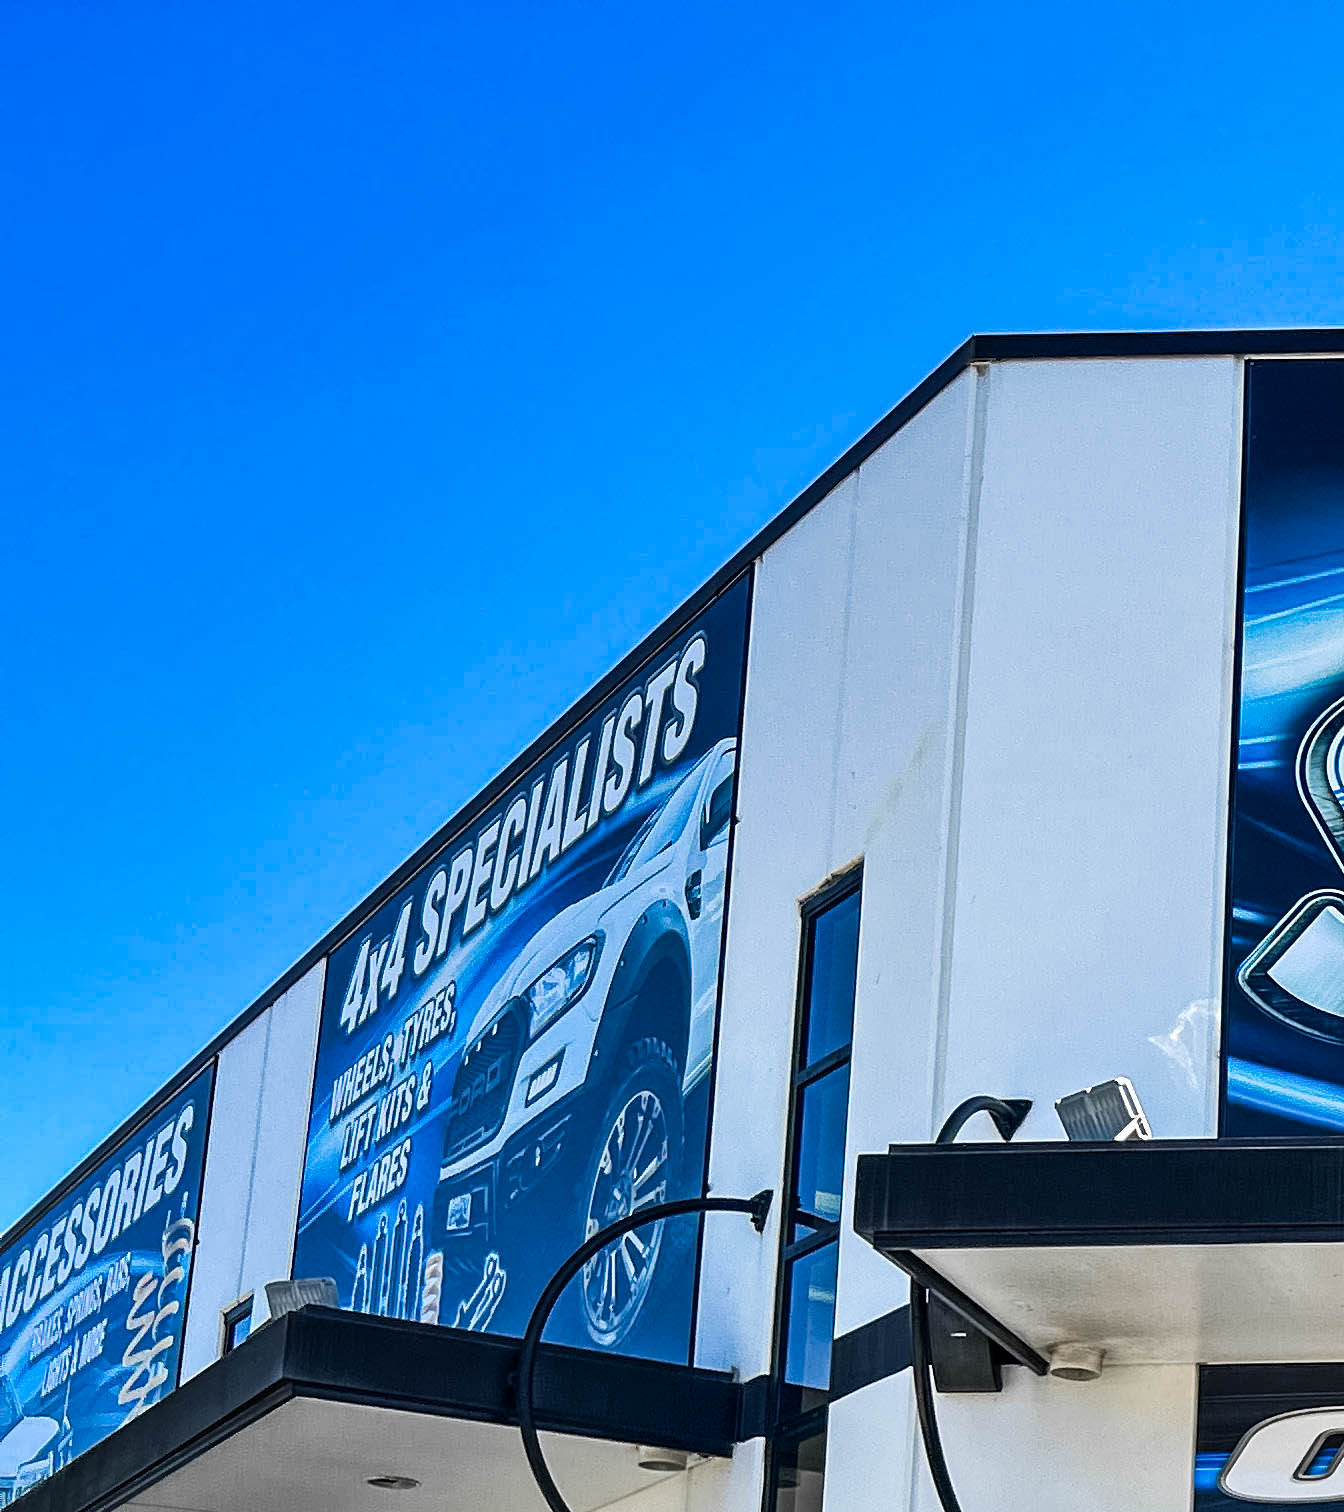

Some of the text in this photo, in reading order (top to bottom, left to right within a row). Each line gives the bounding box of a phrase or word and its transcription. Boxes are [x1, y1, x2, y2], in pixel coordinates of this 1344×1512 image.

[340, 634, 707, 1034] 4x4 SPECIALISTS
[330, 981, 456, 1122] WHEELS, TYRES,
[340, 1061, 433, 1170] LIFT KITS &
[348, 1138, 411, 1222] FLARES
